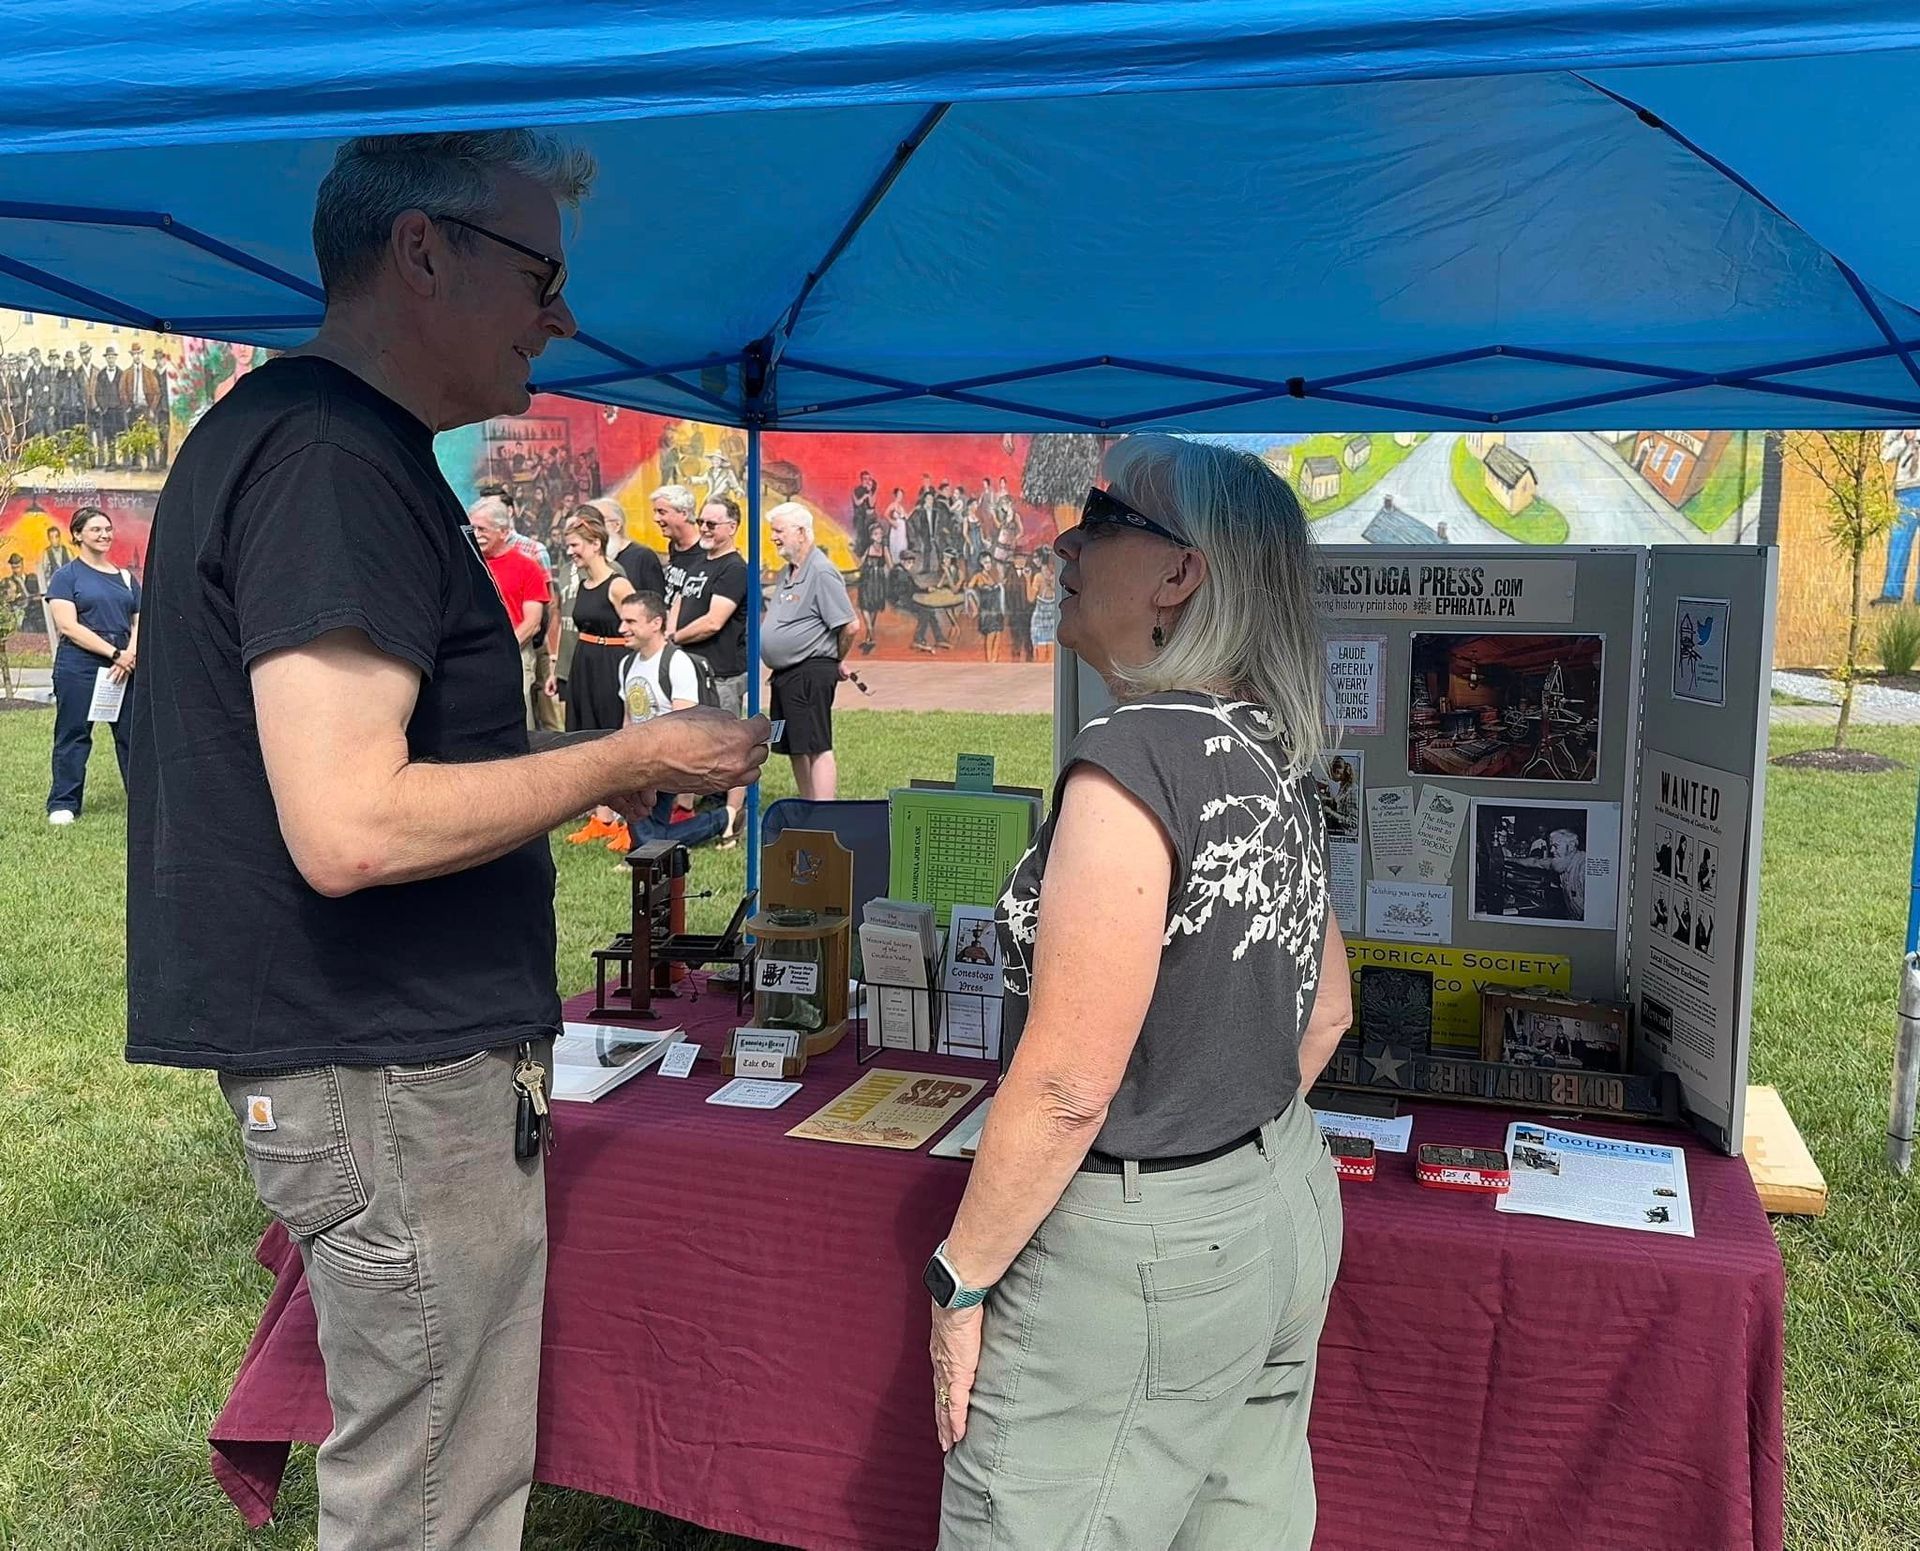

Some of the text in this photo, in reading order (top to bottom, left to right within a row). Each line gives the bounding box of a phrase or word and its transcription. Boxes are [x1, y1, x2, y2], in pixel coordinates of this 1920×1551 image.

[1315, 565, 1523, 598] ONESTOGA PRESS .COM
[1335, 599, 1365, 613] history
[1366, 599, 1386, 614] print
[1387, 599, 1408, 614] shop
[1436, 597, 1496, 616] EPHRATA,
[1499, 598, 1516, 616] PA
[1336, 677, 1368, 691] WEARY
[1661, 770, 1720, 822] WANTED
[1422, 812, 1435, 822] The
[1422, 839, 1453, 854] BOOKS
[911, 860, 921, 903] ALIFORNIA
[1346, 946, 1560, 975] STORICAL SOCIETY
[951, 966, 994, 983] Conestoga
[959, 981, 984, 993] Press
[1643, 1000, 1671, 1031] Reward
[742, 1058, 776, 1068] Take One
[1545, 1131, 1673, 1160] Footprints
